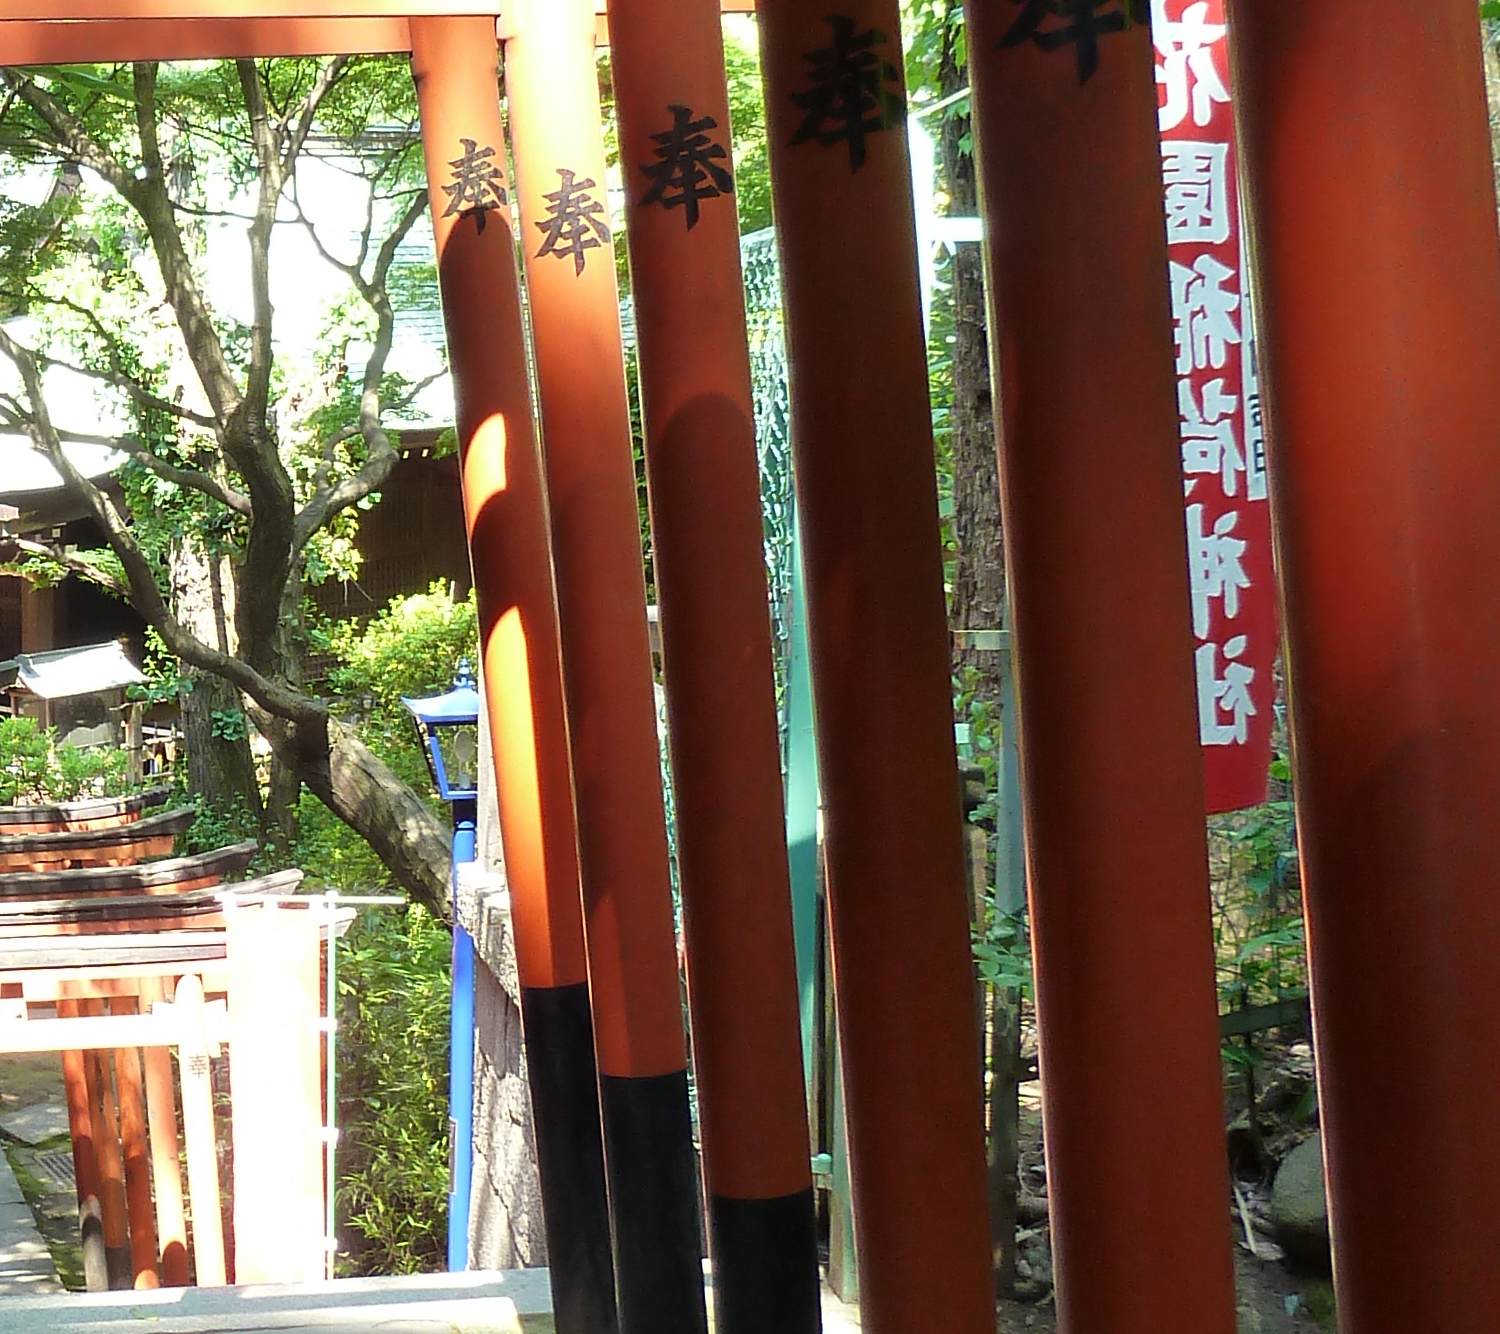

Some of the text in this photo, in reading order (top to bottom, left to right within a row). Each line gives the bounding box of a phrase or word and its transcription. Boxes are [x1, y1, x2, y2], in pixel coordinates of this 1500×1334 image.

[789, 13, 908, 174] 奉
[440, 139, 508, 235] 奉
[534, 168, 611, 278] 奉
[638, 104, 734, 232] 奉
